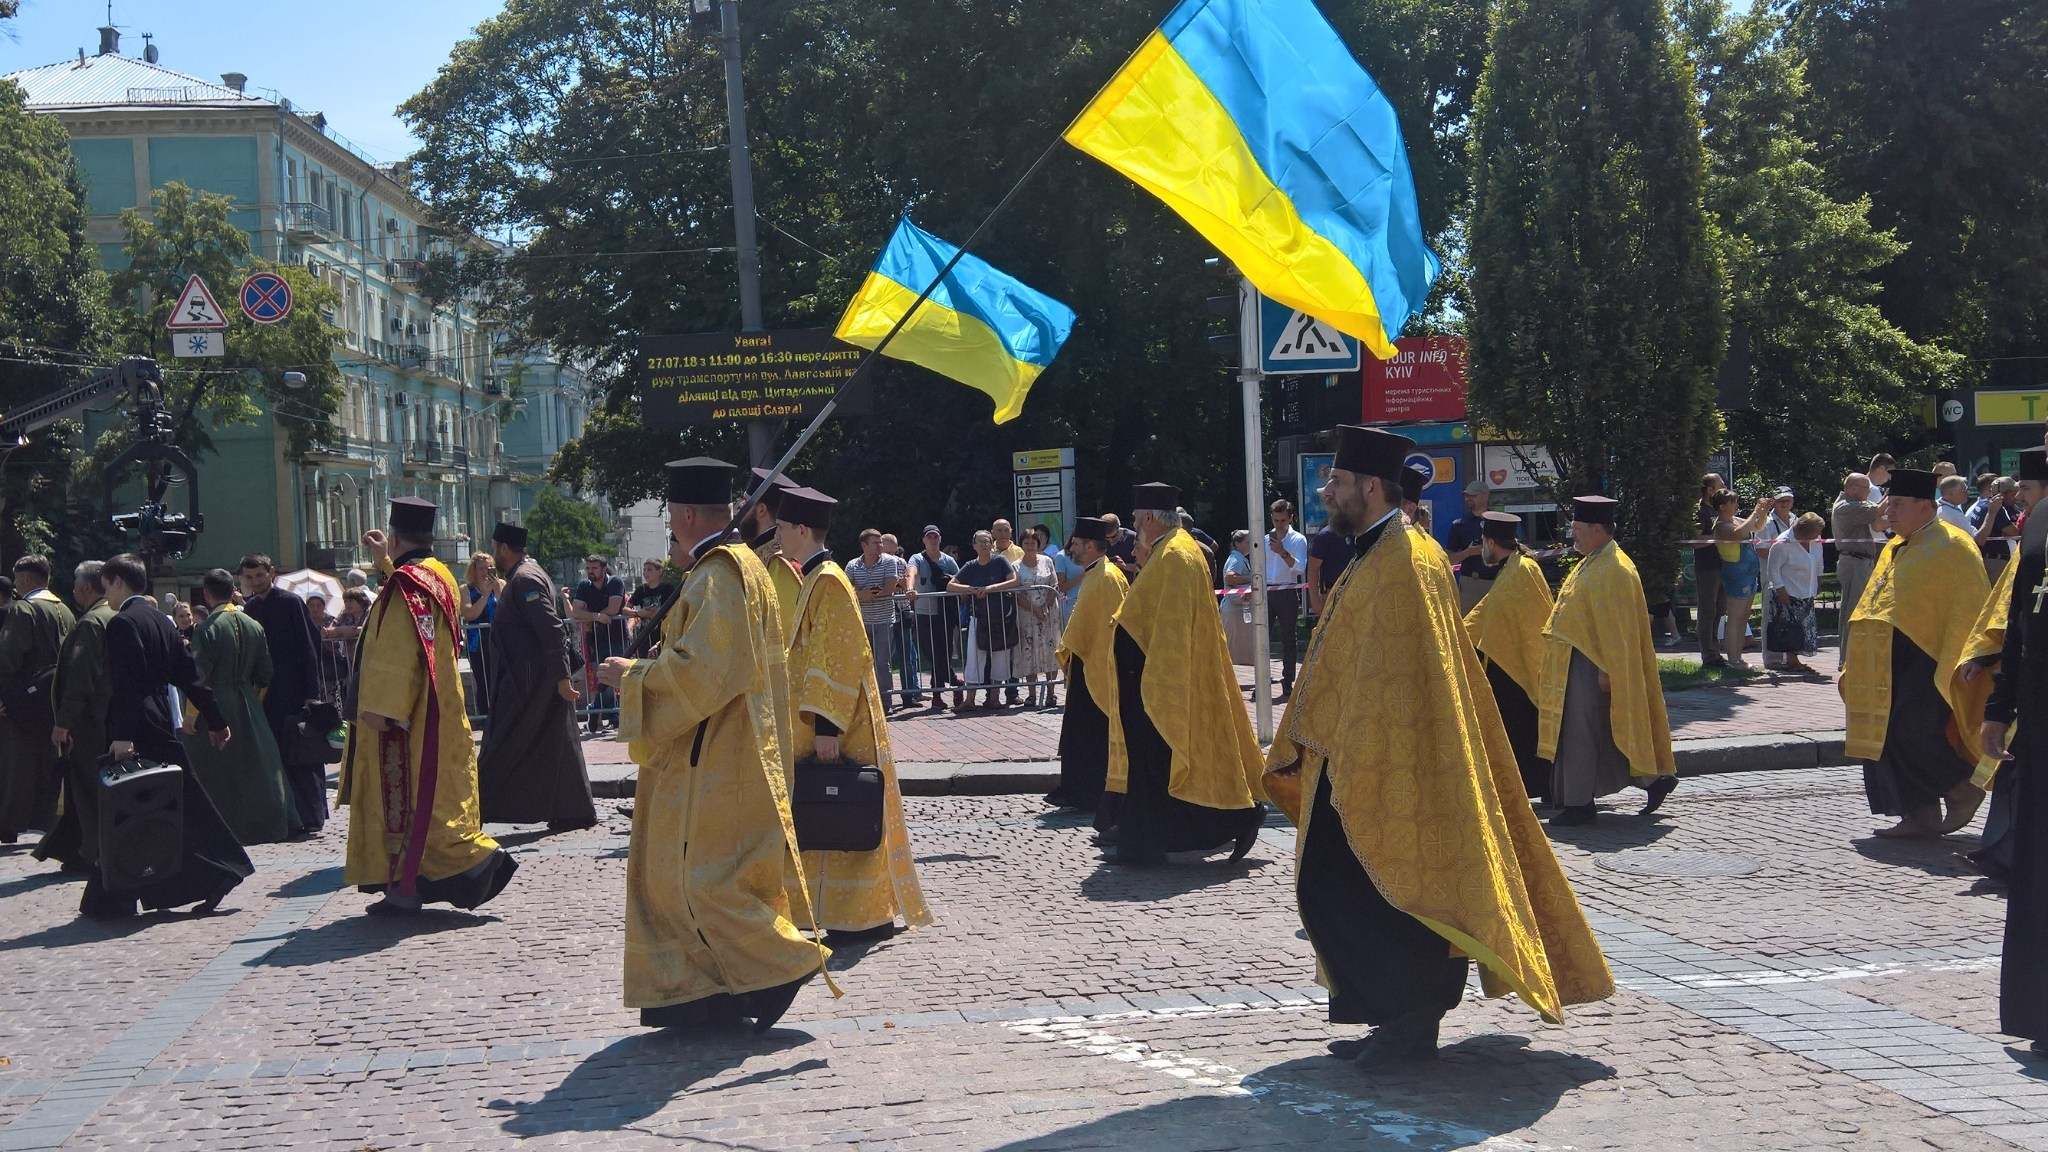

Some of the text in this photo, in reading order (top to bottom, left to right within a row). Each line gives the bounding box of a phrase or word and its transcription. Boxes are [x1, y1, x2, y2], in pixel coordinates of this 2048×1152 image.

[735, 336, 772, 348] Увага!
[648, 356, 698, 369] 27.07.18
[700, 358, 706, 367] з
[710, 353, 741, 366] 11:00
[744, 356, 757, 365] до
[760, 351, 792, 364] 16:30
[1385, 366, 1413, 379] KYIV
[652, 376, 674, 388] руху
[677, 373, 742, 386] транспорту
[678, 389, 719, 404] ділянці
[722, 388, 739, 401] від
[713, 408, 726, 419] до
[1944, 406, 1962, 416] WC
